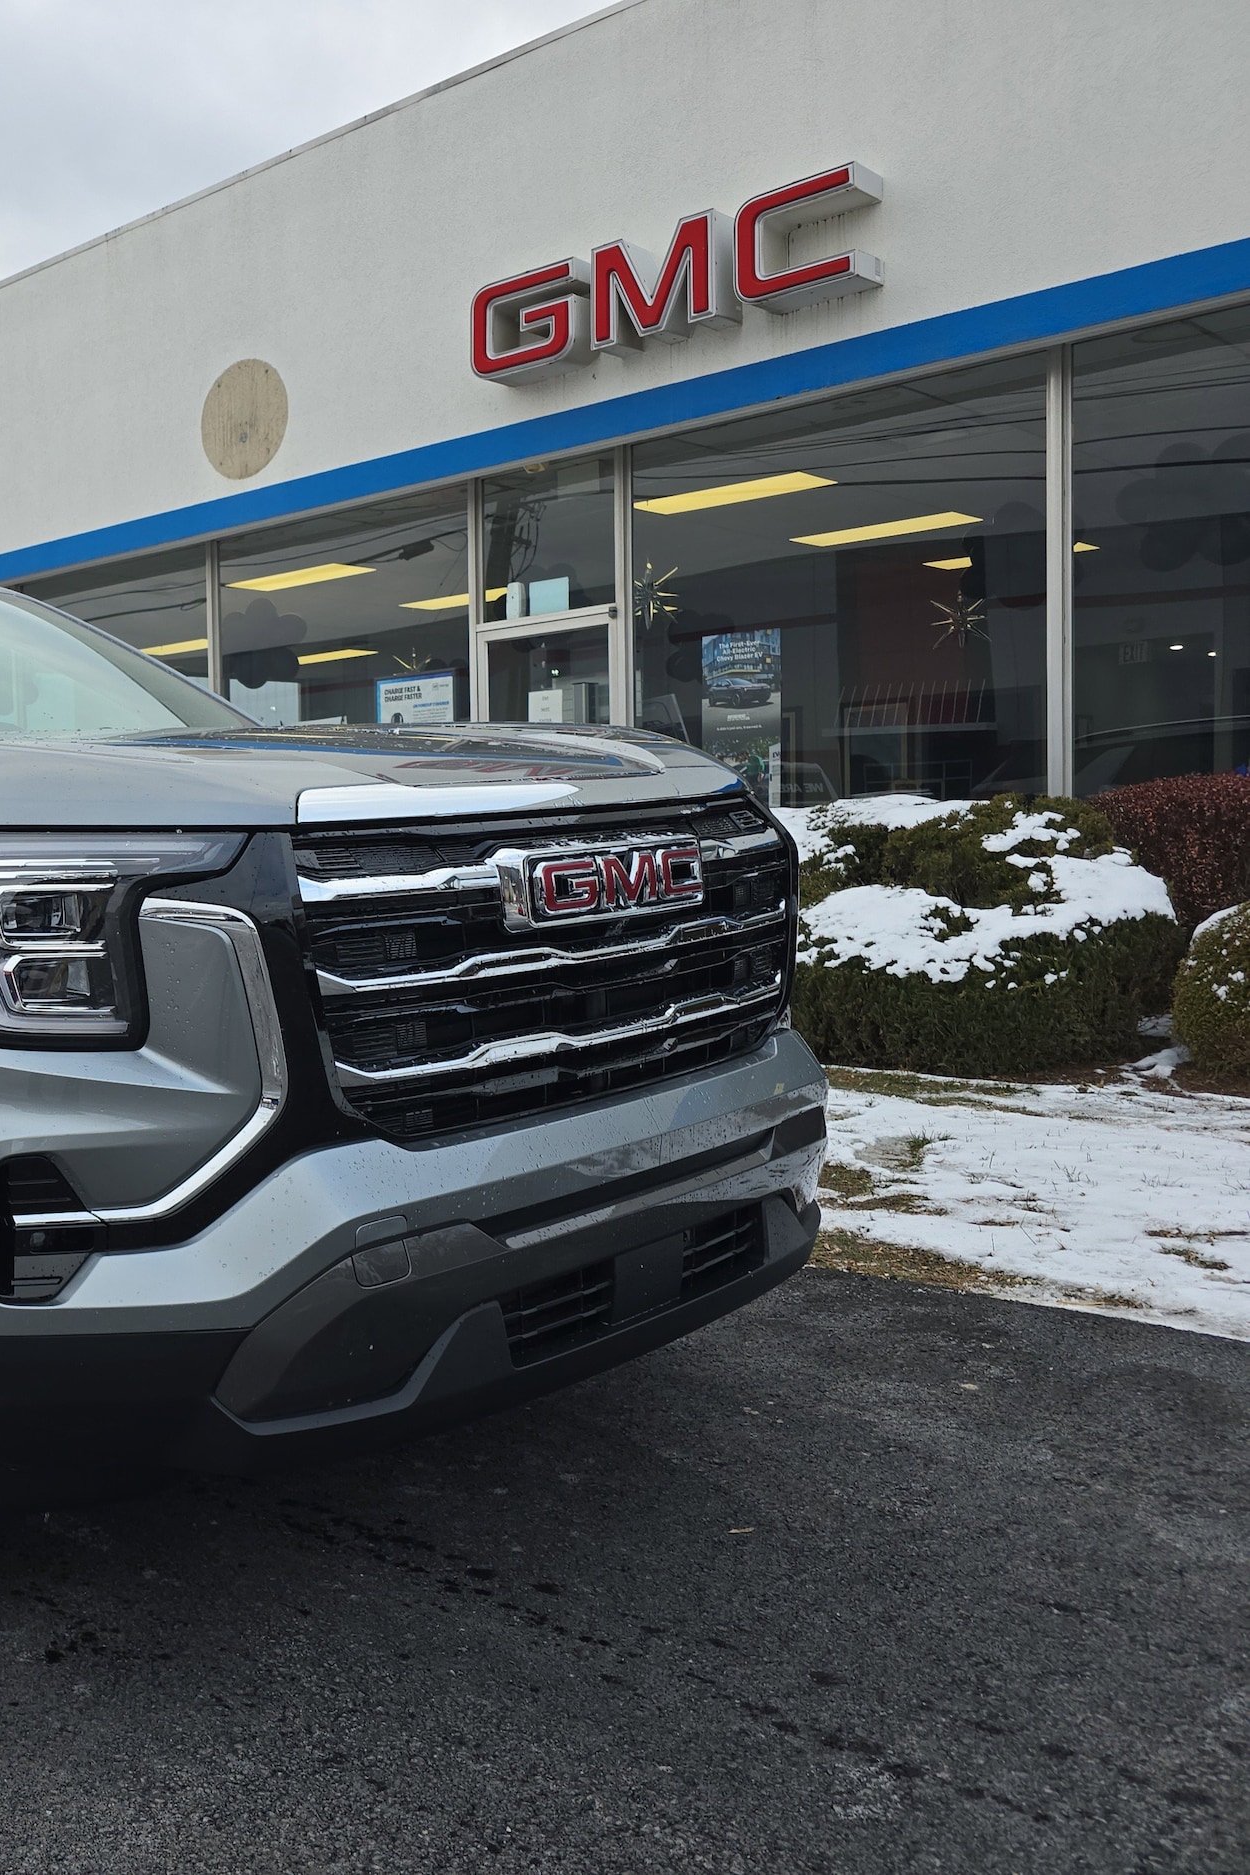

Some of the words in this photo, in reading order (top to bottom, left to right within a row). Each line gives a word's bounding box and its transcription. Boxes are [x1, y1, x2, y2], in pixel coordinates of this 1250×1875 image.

[470, 162, 874, 380] GMC
[718, 642, 729, 650] The
[730, 640, 760, 648] First-Ever
[722, 646, 756, 655] All-Electric
[716, 653, 733, 662] Chevy
[734, 652, 753, 660] Blazer
[754, 650, 763, 658] EV
[1123, 644, 1144, 662] EXIT
[384, 687, 403, 695] CHARGE
[384, 694, 403, 703] CHARGE
[404, 692, 422, 701] FASTER
[538, 849, 702, 914] GMC
